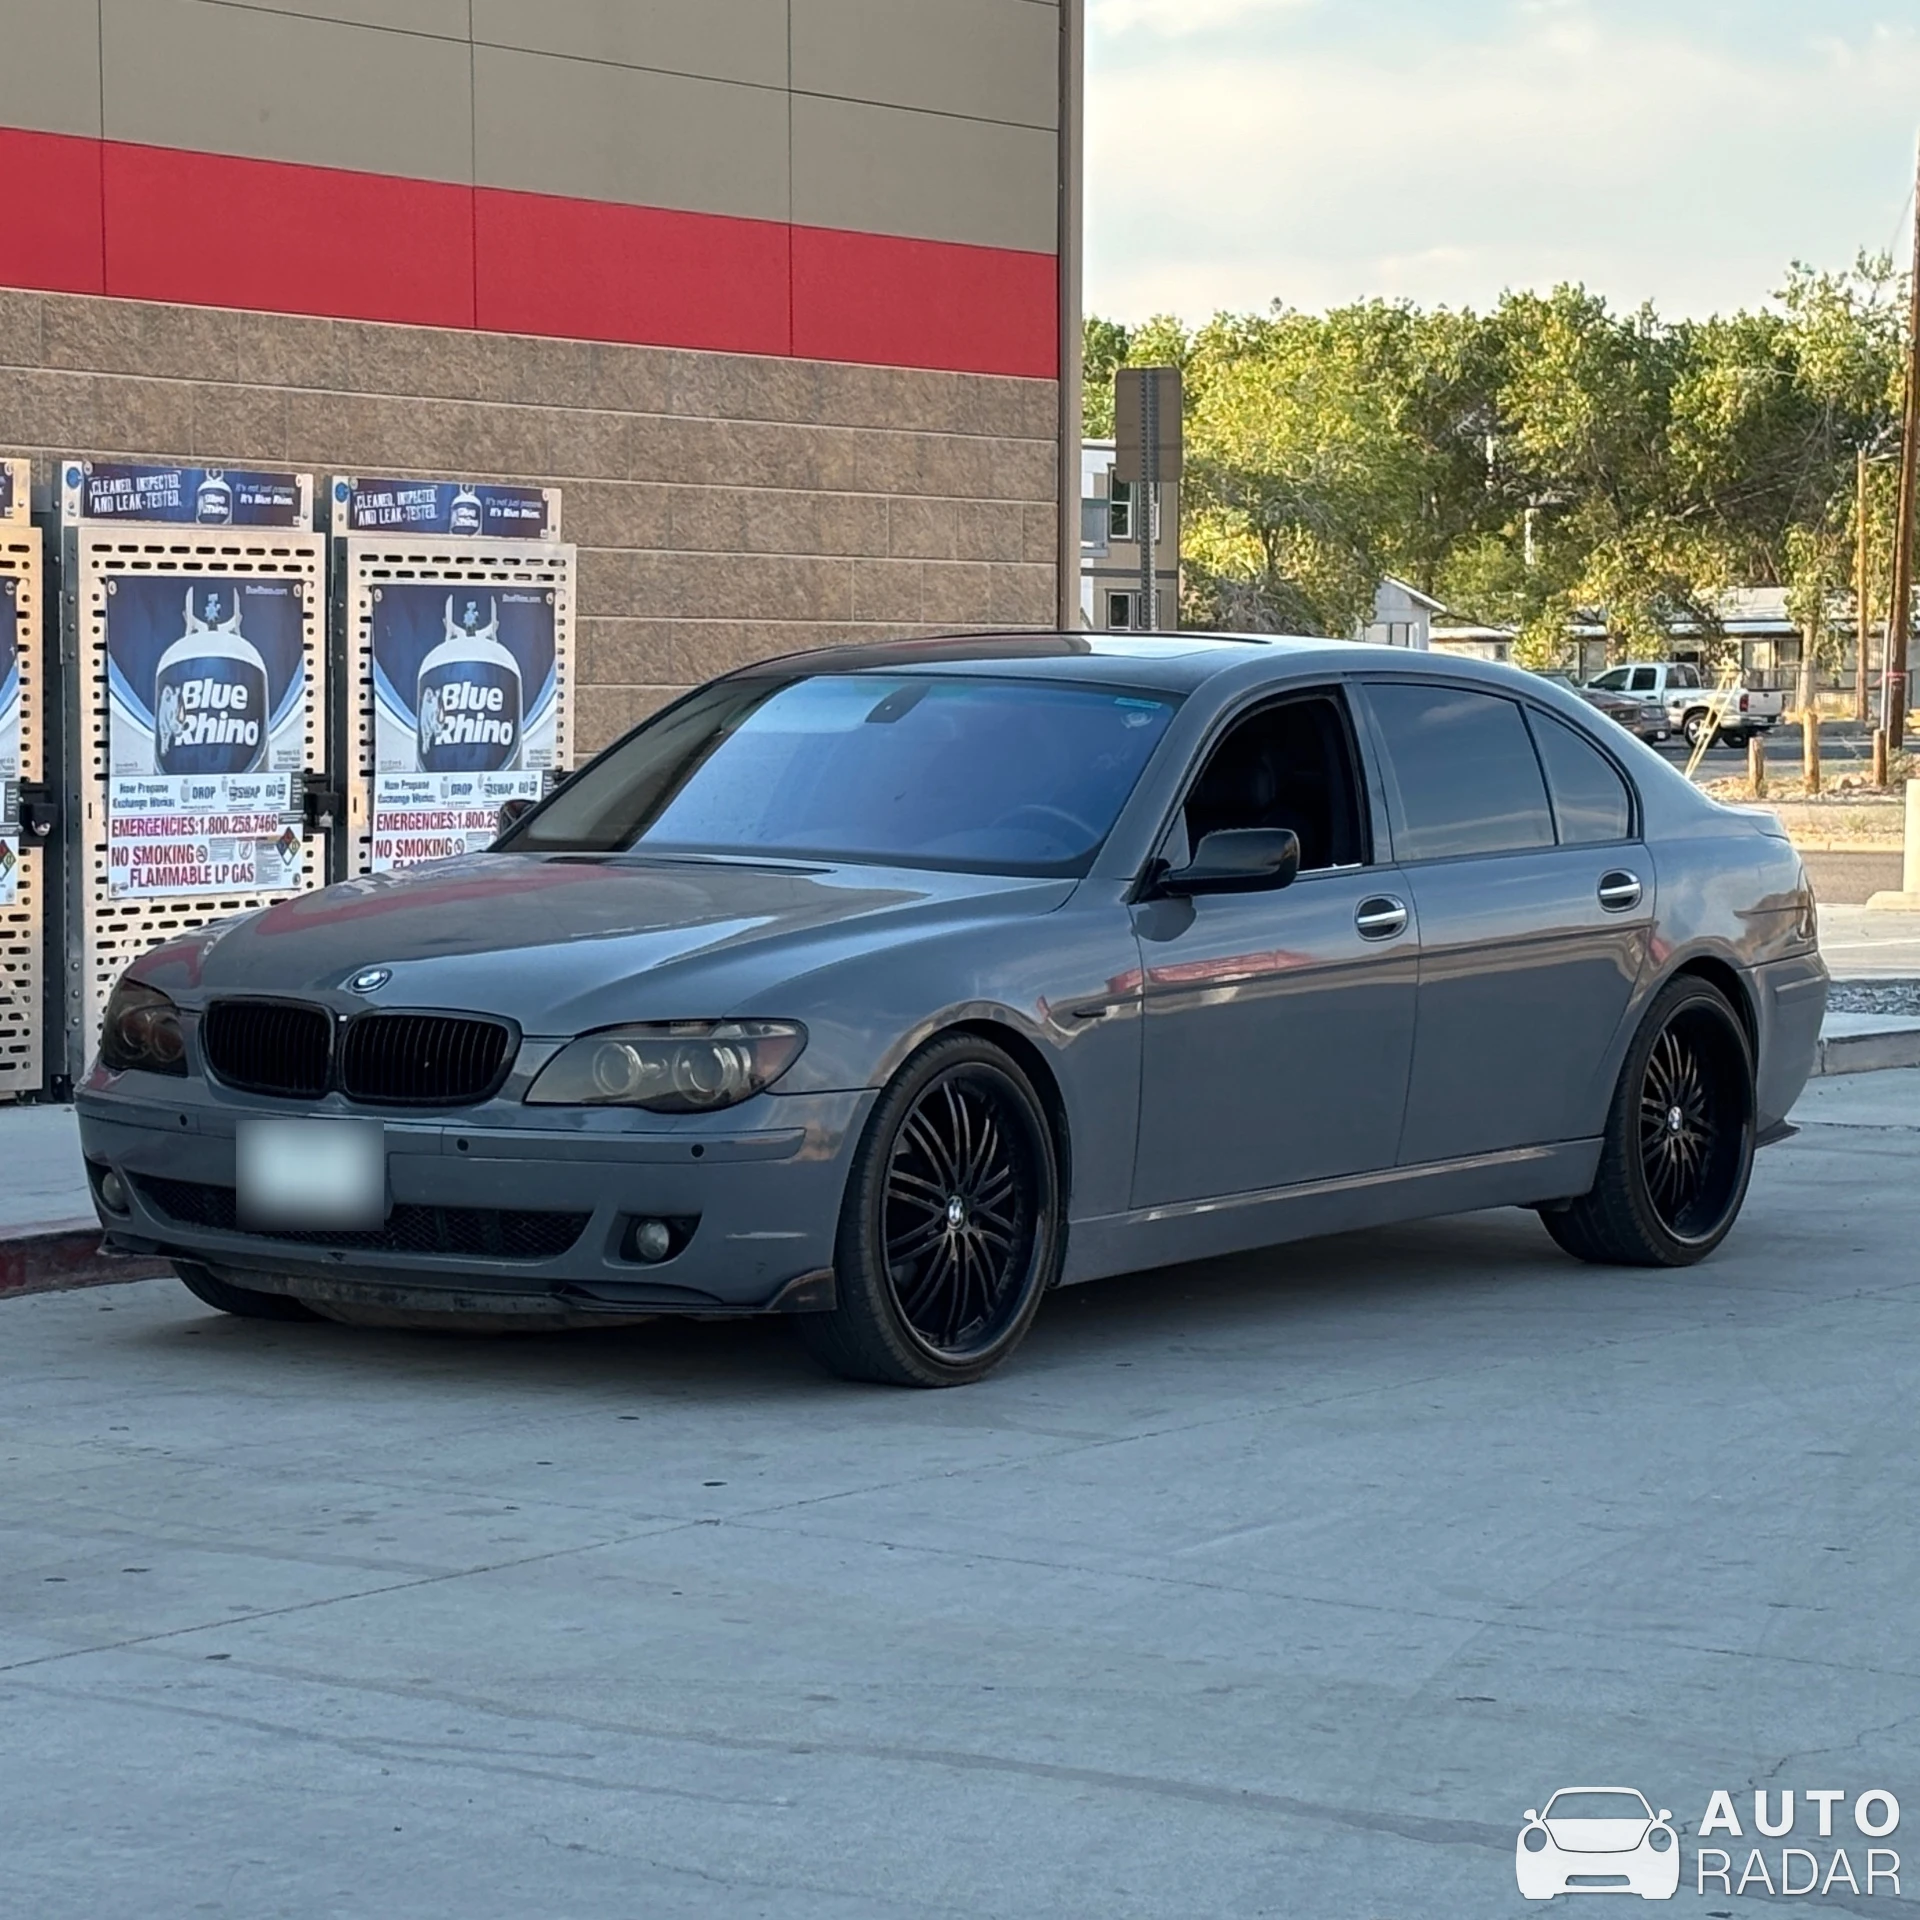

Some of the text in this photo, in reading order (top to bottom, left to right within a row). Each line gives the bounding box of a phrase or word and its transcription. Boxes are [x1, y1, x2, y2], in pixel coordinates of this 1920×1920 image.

[93, 496, 114, 513] AND
[358, 509, 377, 526] AND
[182, 678, 248, 710] Blue
[442, 681, 503, 711] Blue
[174, 710, 259, 746] Rhino
[435, 712, 513, 746] Rhino
[192, 785, 216, 799] DROP
[451, 783, 473, 796] DROP
[111, 845, 129, 867] NO
[132, 844, 195, 866] SMOKING
[374, 838, 392, 859] NO
[395, 836, 453, 858] SMOKING
[130, 863, 255, 888] FLAMMABLE LP GAS
